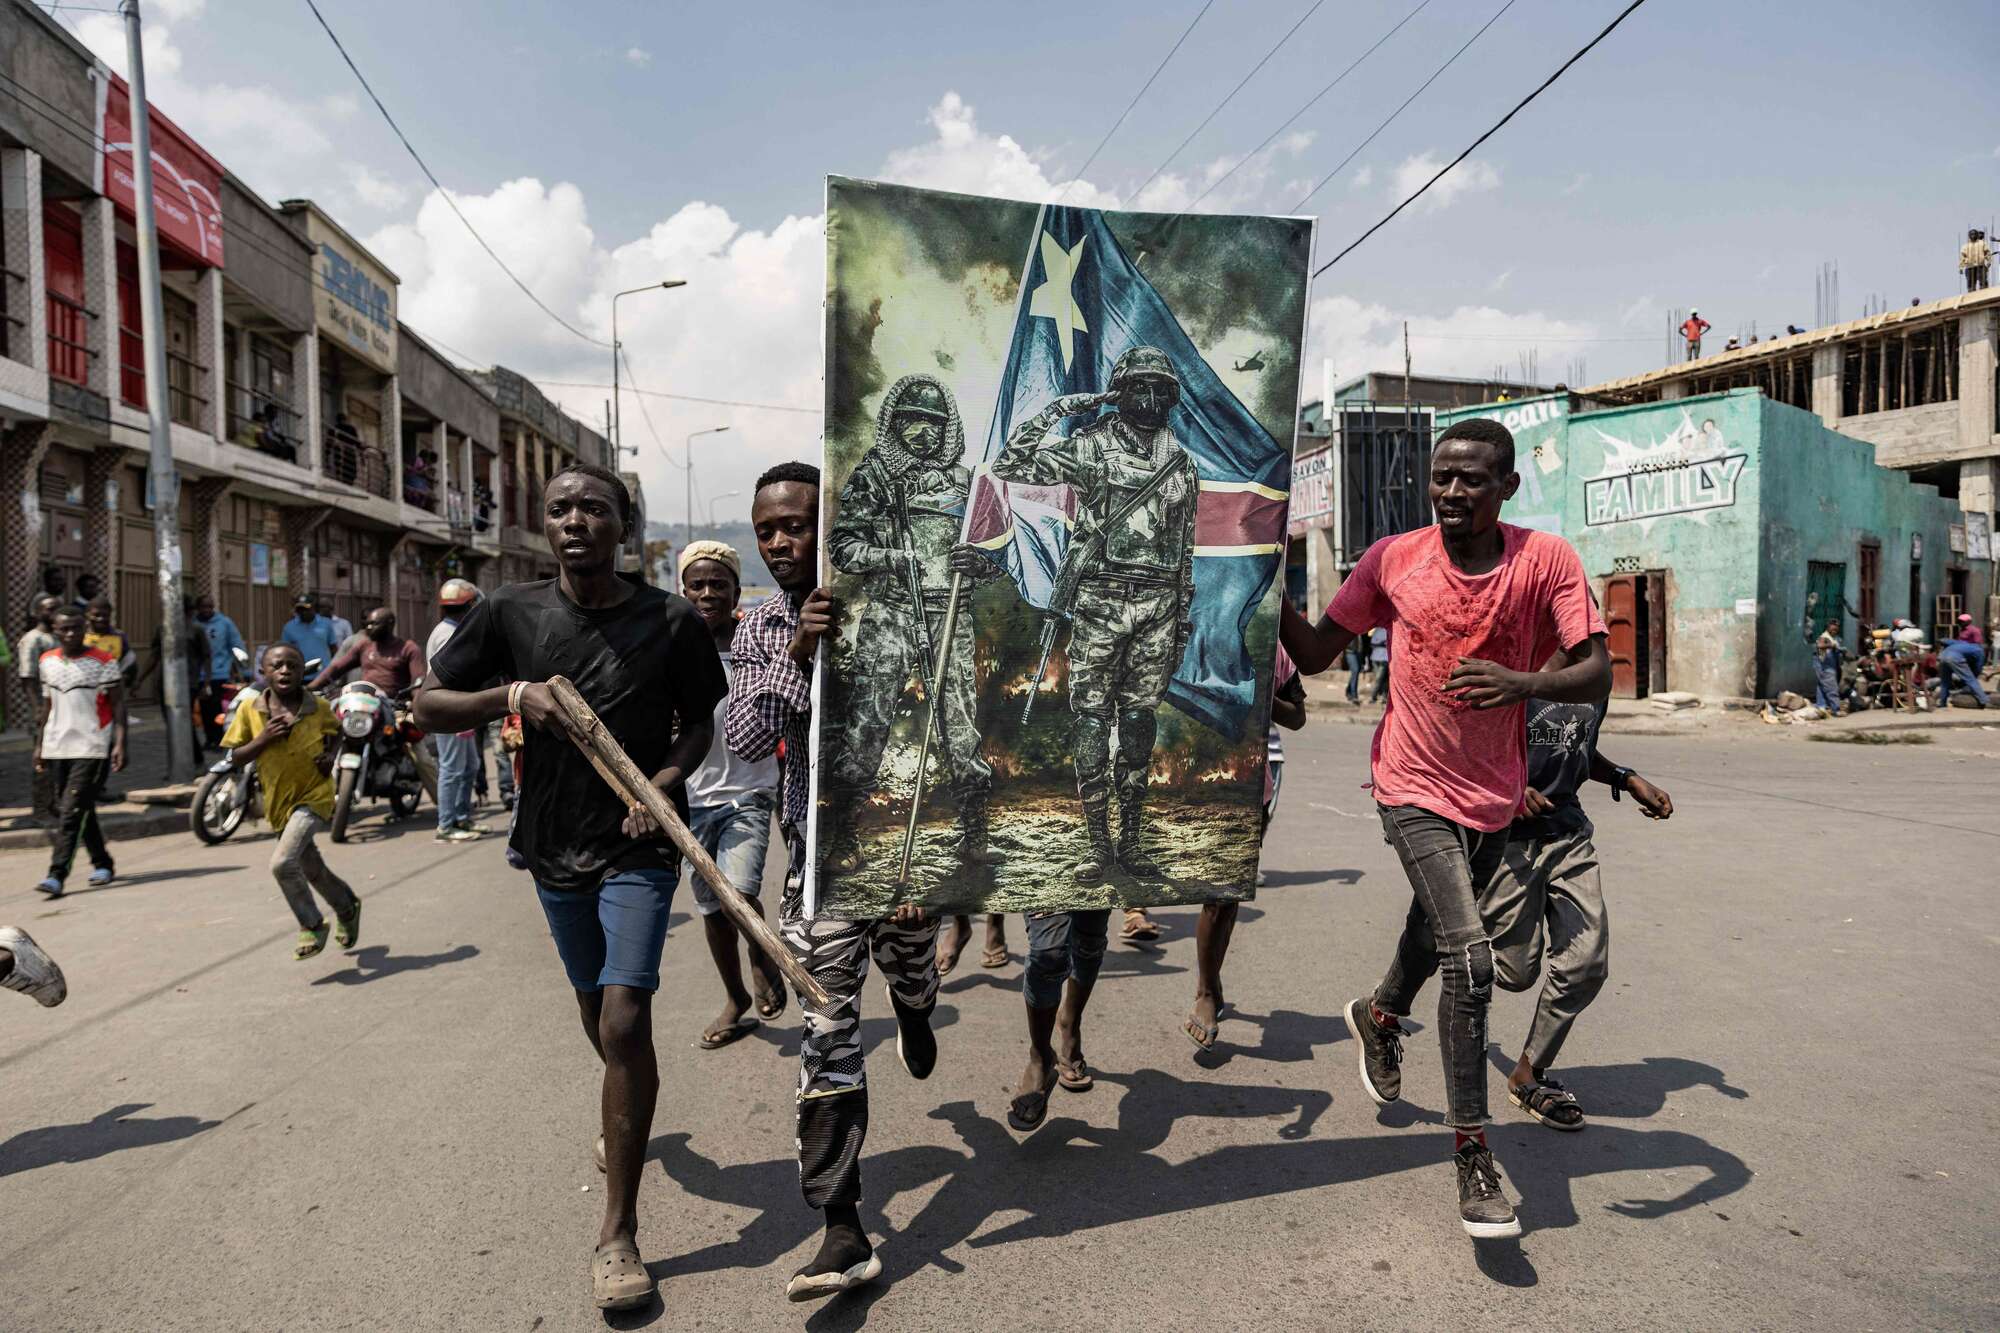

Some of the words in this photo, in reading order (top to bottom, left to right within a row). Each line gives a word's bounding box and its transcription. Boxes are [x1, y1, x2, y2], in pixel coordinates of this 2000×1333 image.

[1480, 400, 1562, 435] ean
[1292, 457, 1327, 479] SAVON
[1586, 457, 1746, 526] FAMILY
